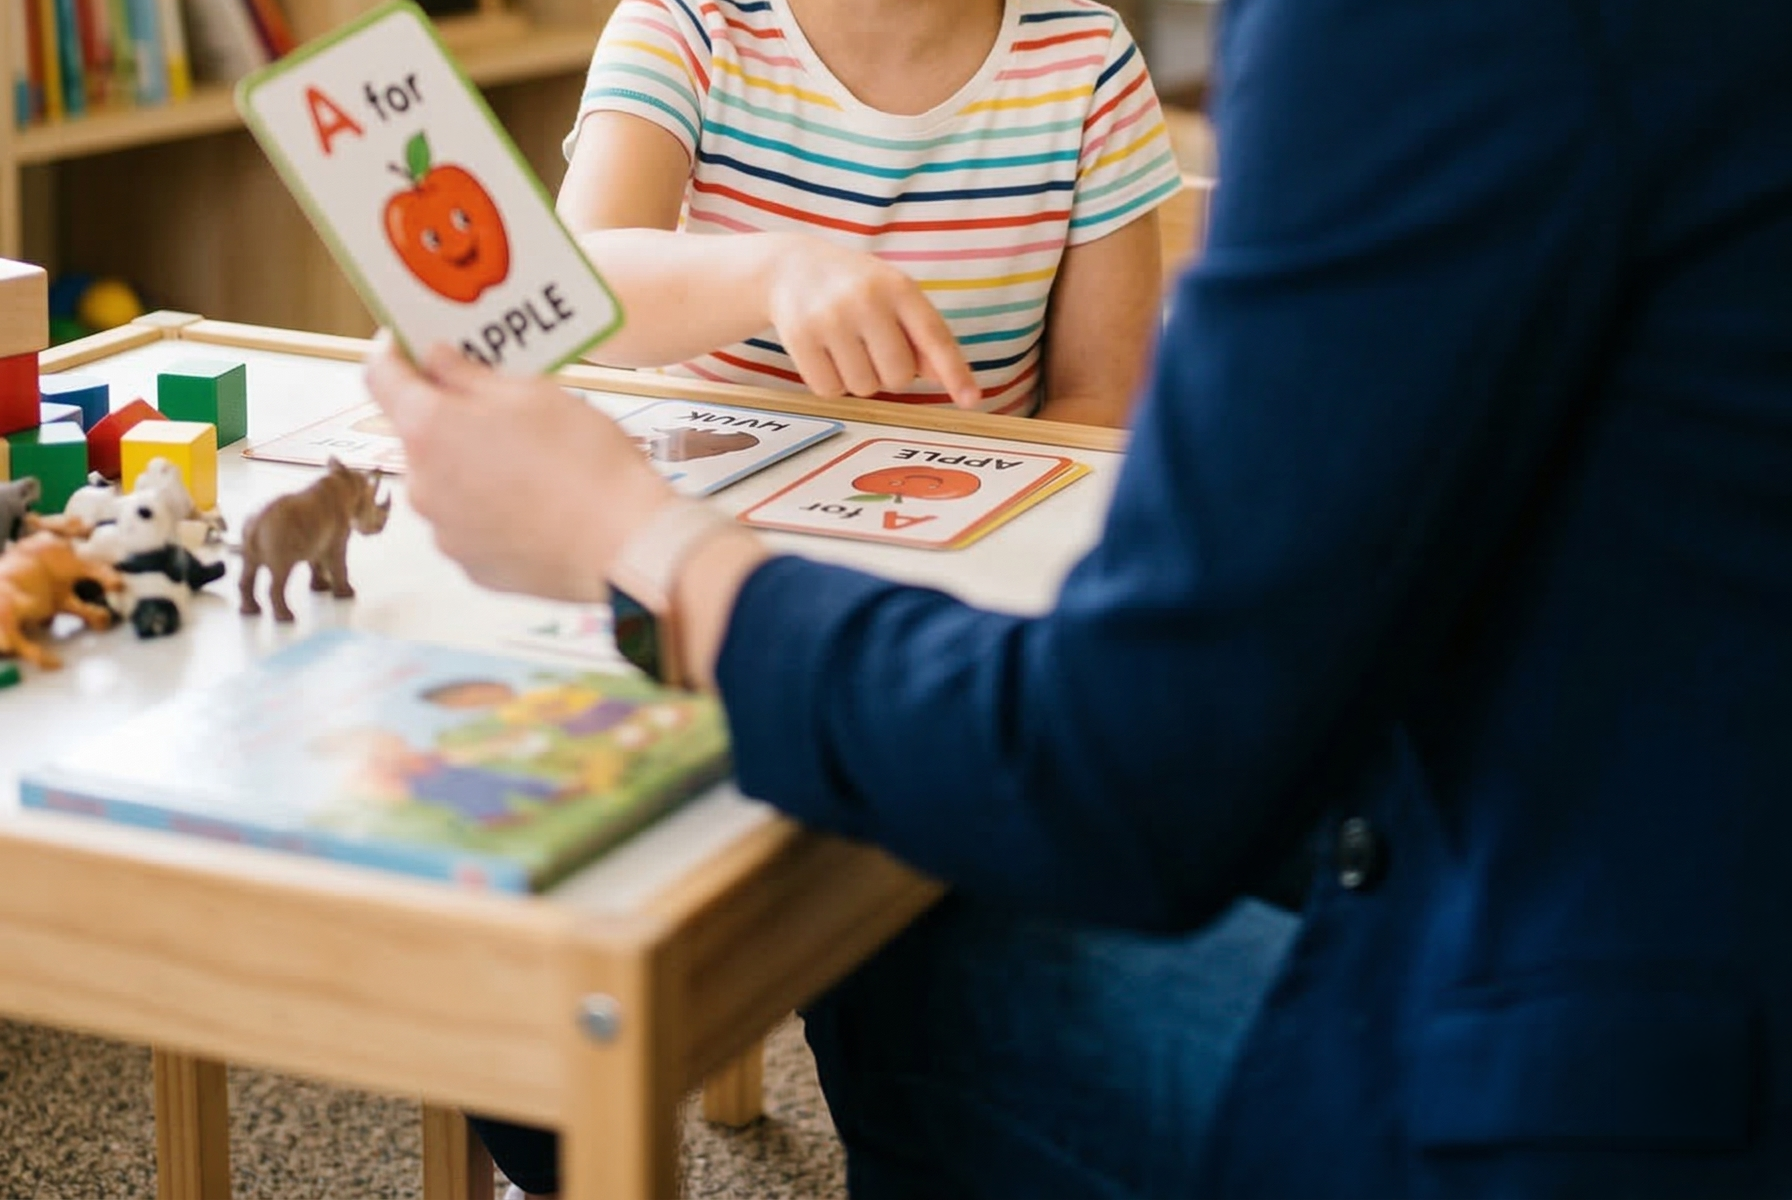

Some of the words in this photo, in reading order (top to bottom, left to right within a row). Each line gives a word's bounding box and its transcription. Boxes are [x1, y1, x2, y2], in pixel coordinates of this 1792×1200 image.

[303, 84, 364, 157] A
[363, 73, 424, 122] for
[893, 448, 1024, 471] APPLE
[799, 502, 864, 520] for
[882, 510, 940, 531] A
